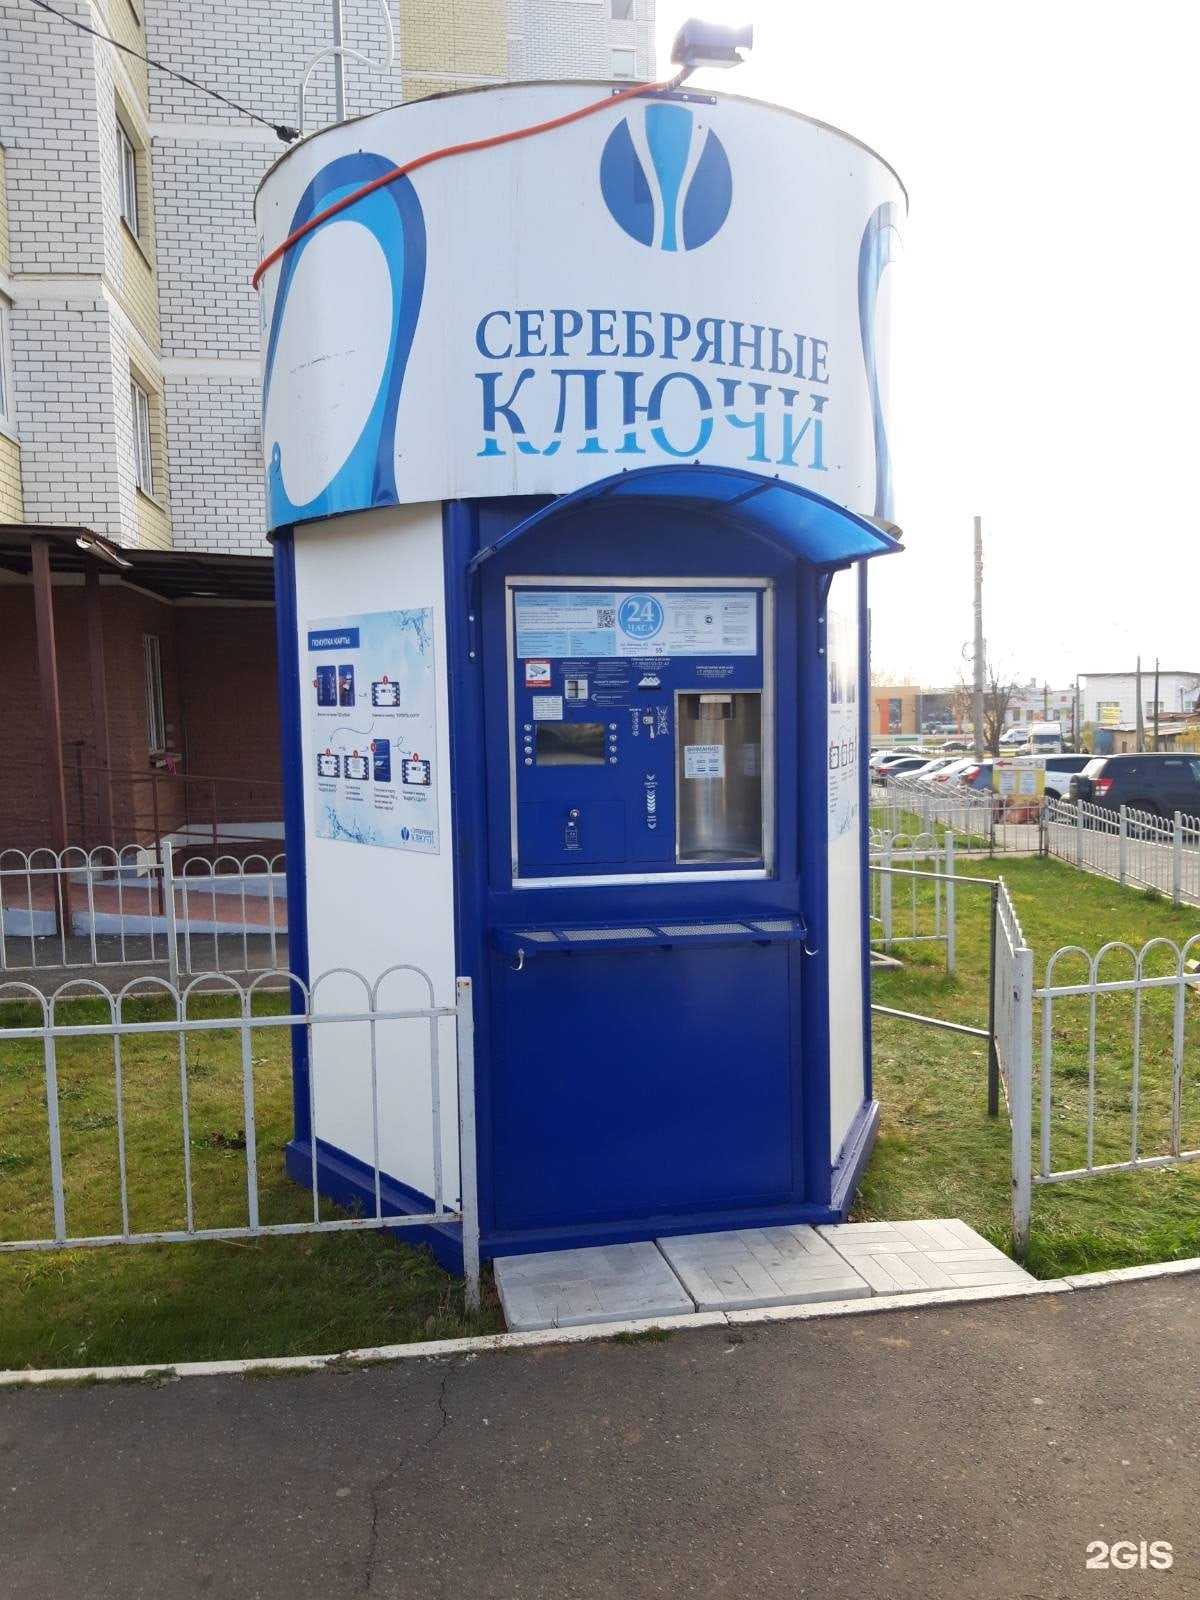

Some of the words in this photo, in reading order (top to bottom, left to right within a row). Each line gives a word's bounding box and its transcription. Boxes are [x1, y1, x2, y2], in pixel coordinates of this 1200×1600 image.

[475, 309, 830, 385] СЕРЕБРЯНЫЕ
[474, 368, 830, 472] КЛЮЧИ
[627, 600, 655, 623] 24
